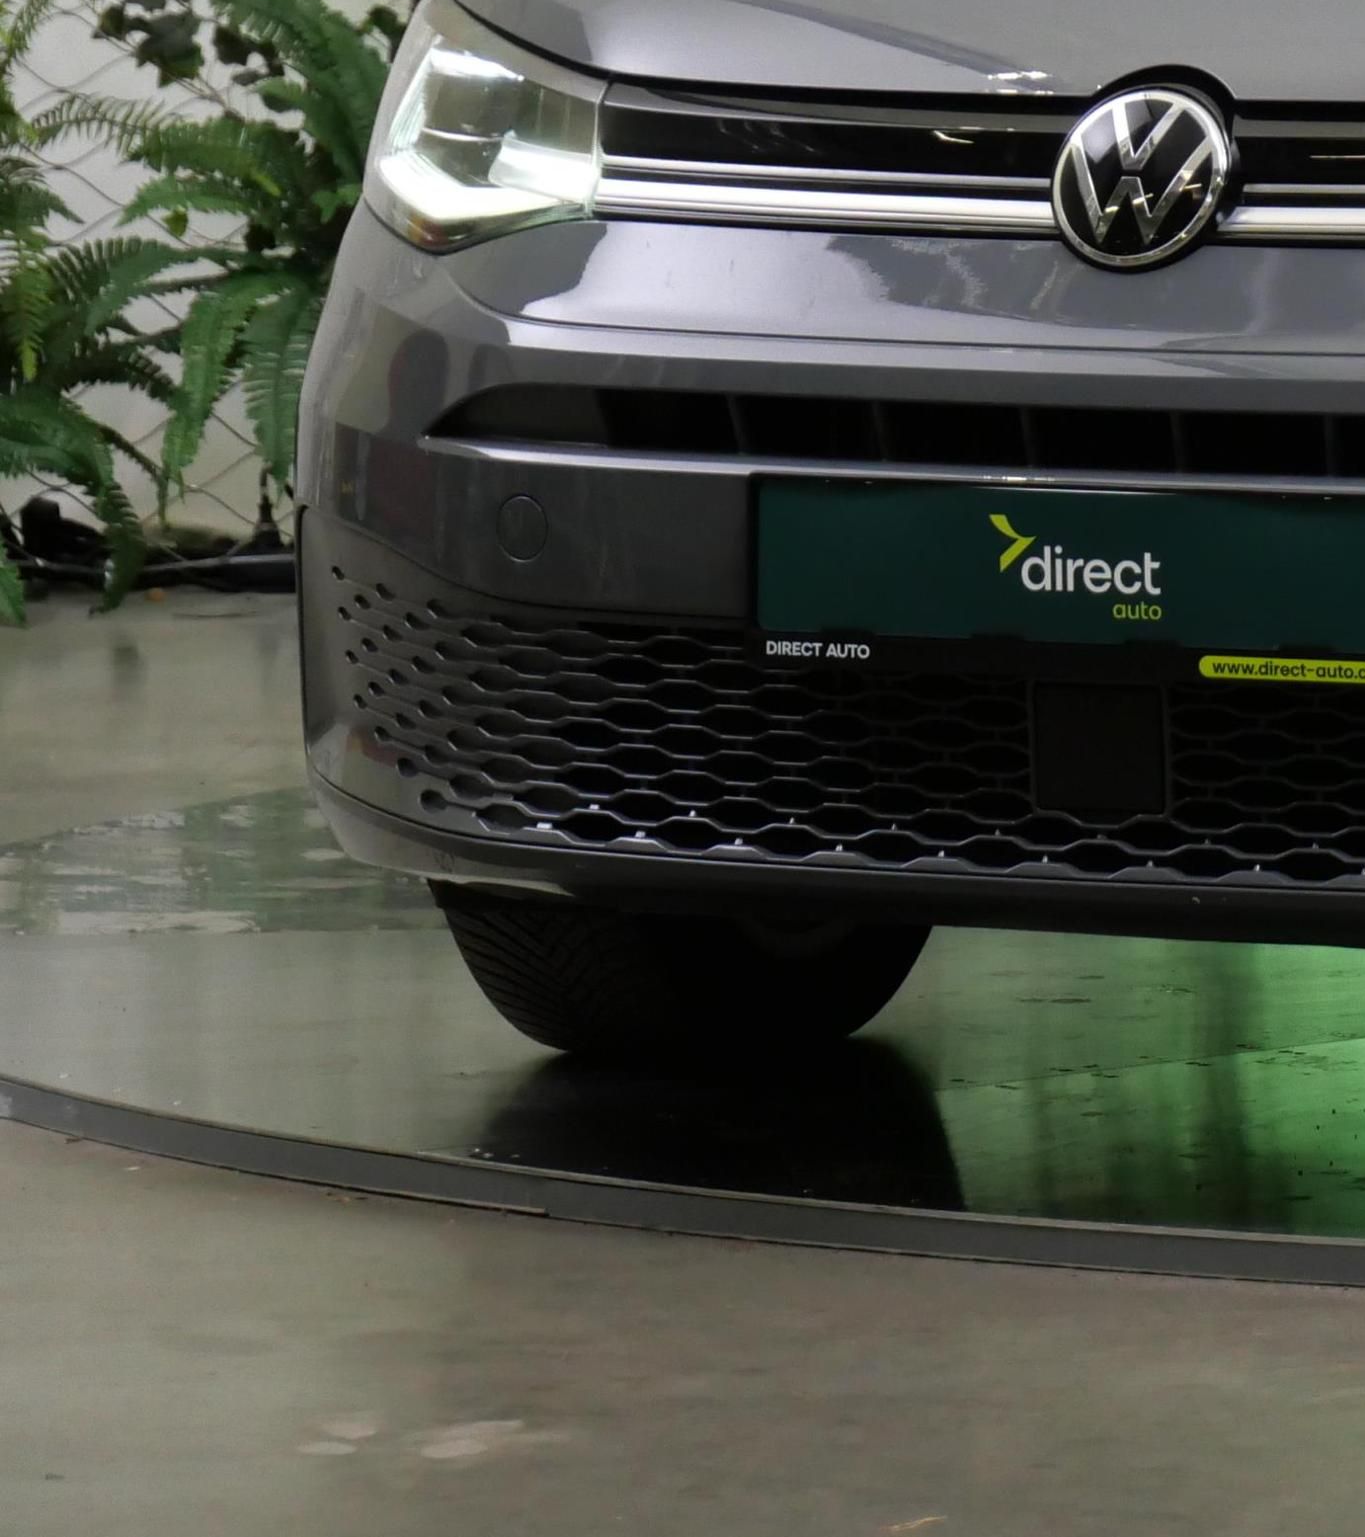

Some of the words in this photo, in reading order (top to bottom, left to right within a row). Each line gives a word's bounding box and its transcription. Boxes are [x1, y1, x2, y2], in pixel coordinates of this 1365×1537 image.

[1021, 545, 1162, 595] direct
[1112, 601, 1162, 620] auto
[765, 640, 823, 657] DIRECT
[825, 642, 871, 659] AUTO
